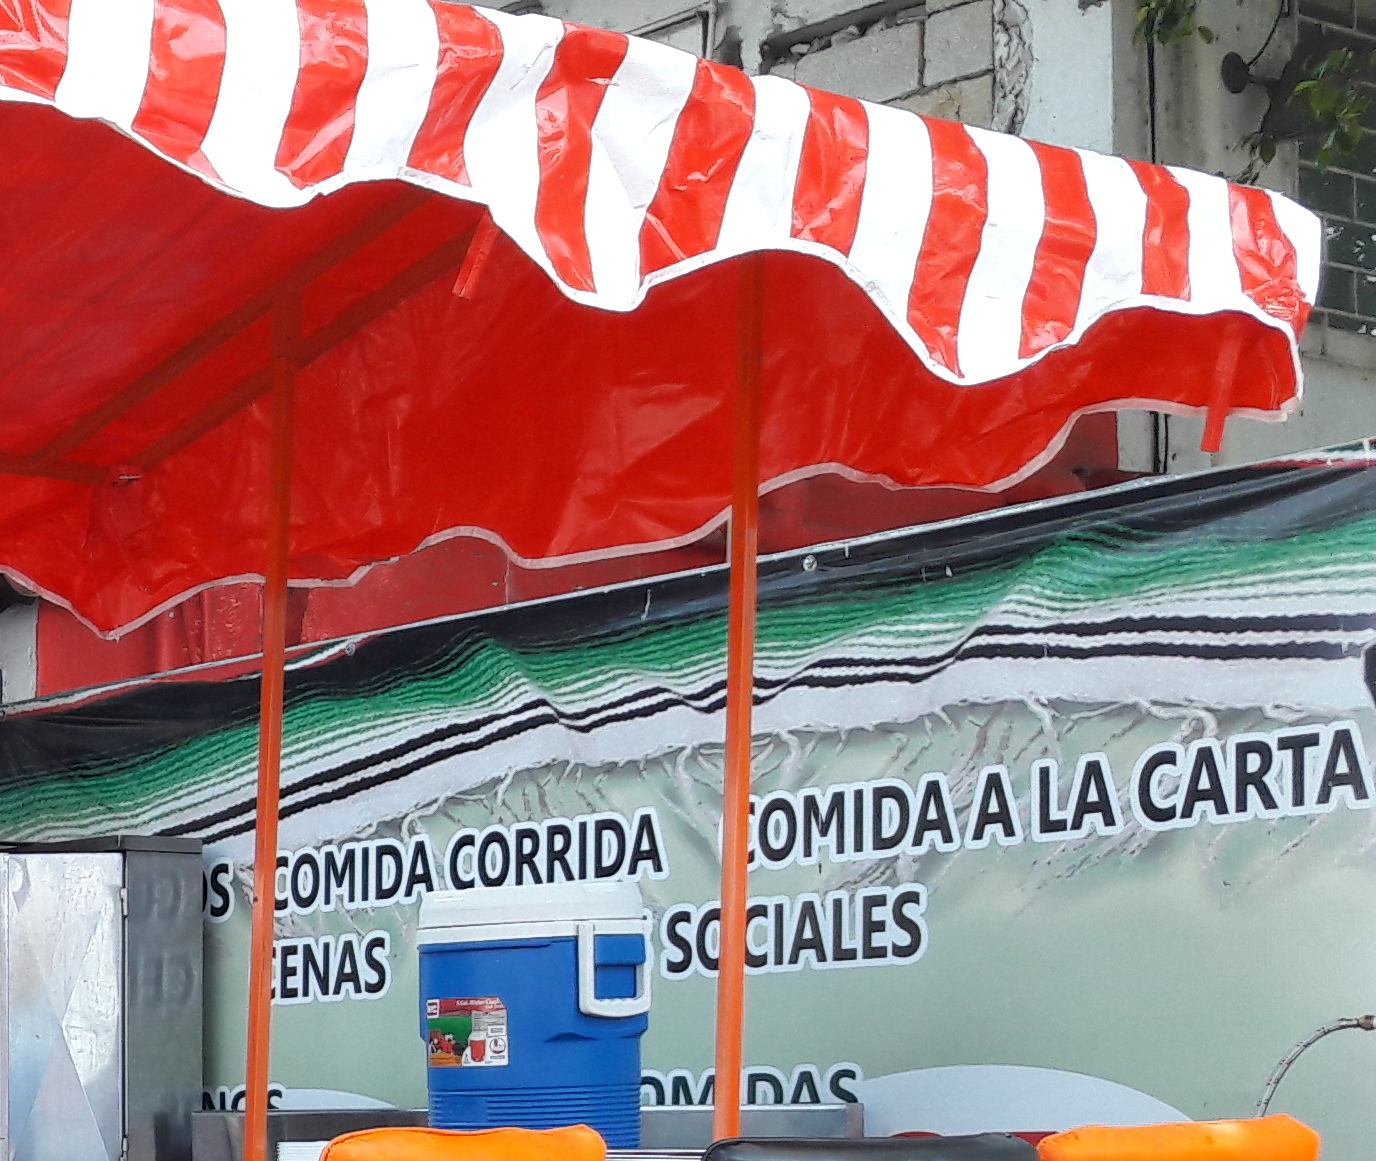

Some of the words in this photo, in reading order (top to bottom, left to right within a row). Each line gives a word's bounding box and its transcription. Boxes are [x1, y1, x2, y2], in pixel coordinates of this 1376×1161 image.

[449, 813, 664, 890] CORRIDA
[747, 779, 954, 866] OMIDA
[970, 771, 1018, 843] A
[1039, 759, 1116, 835] LA
[1137, 728, 1370, 823] CARTA
[270, 936, 387, 1000] ENAS
[666, 890, 922, 973] SOCIALES
